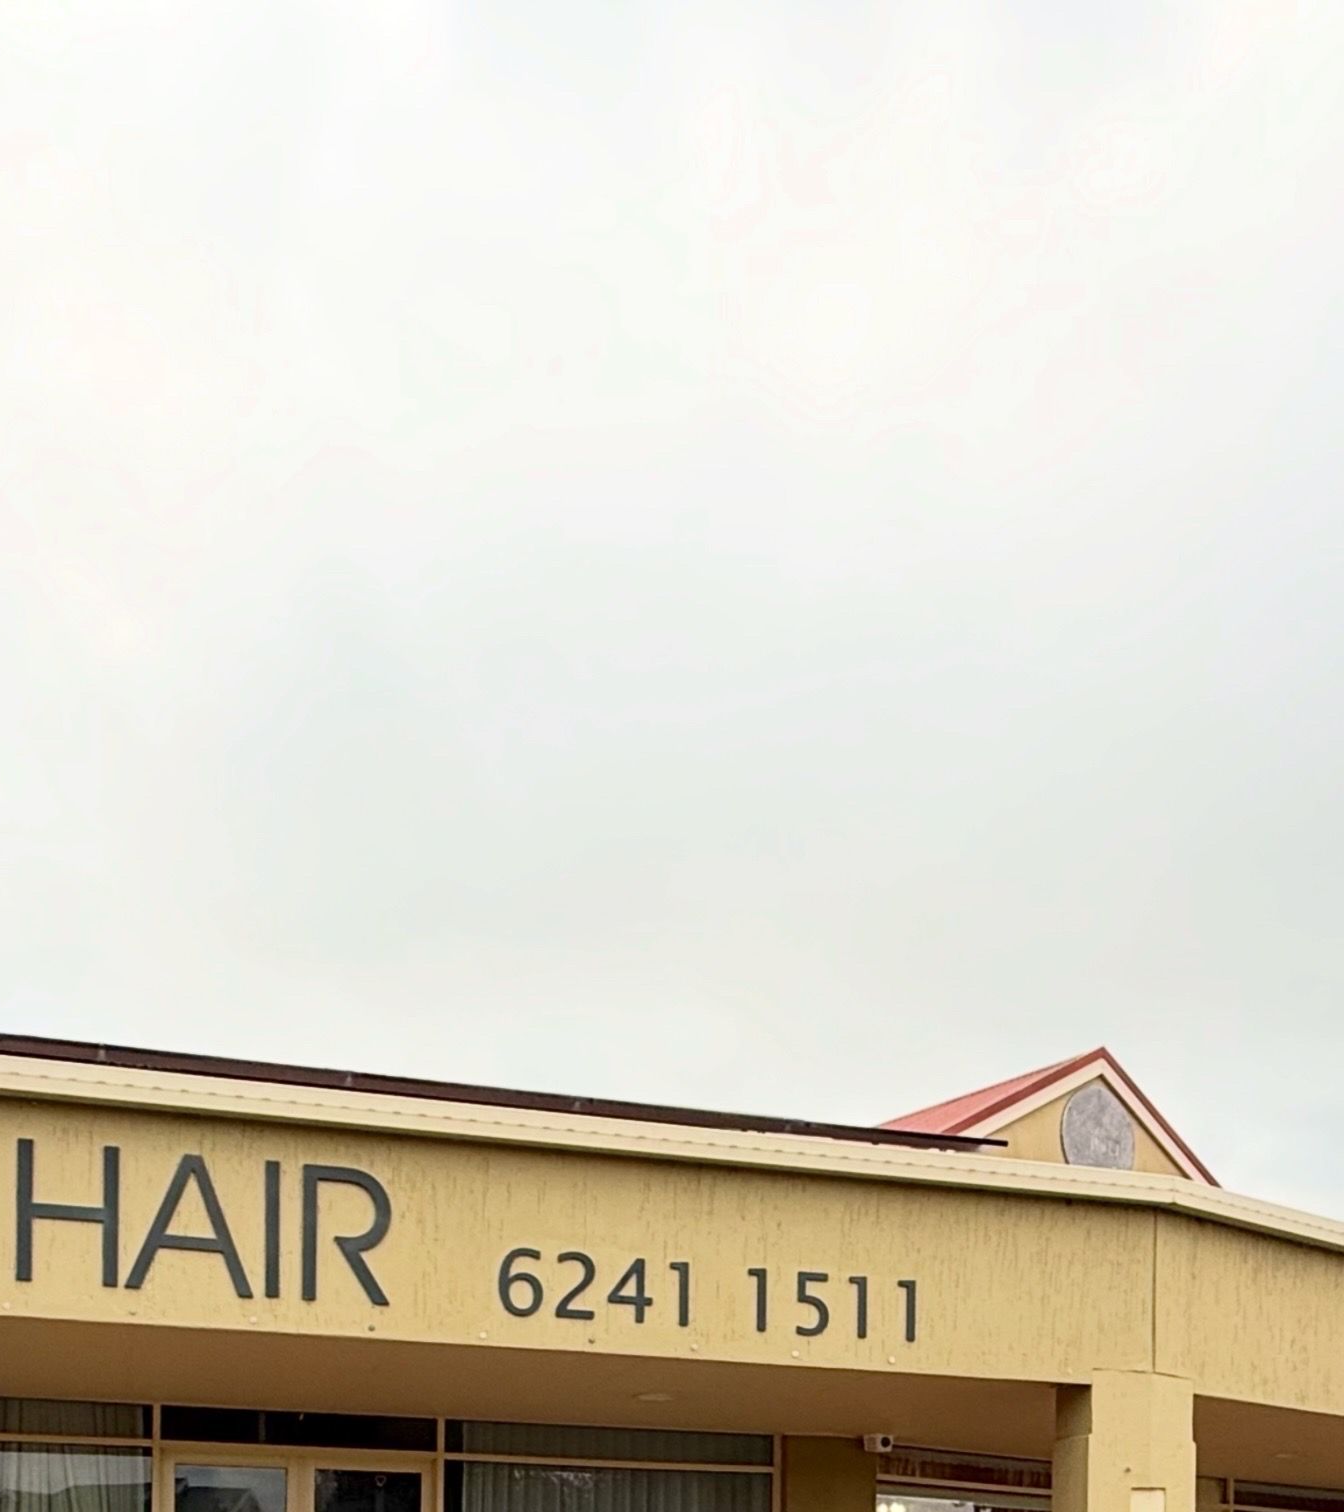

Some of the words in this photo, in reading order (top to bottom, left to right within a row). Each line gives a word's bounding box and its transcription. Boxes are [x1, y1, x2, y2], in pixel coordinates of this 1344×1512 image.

[16, 1138, 392, 1306] HAIR
[498, 1247, 689, 1328] 6241
[747, 1267, 916, 1342] 1511
